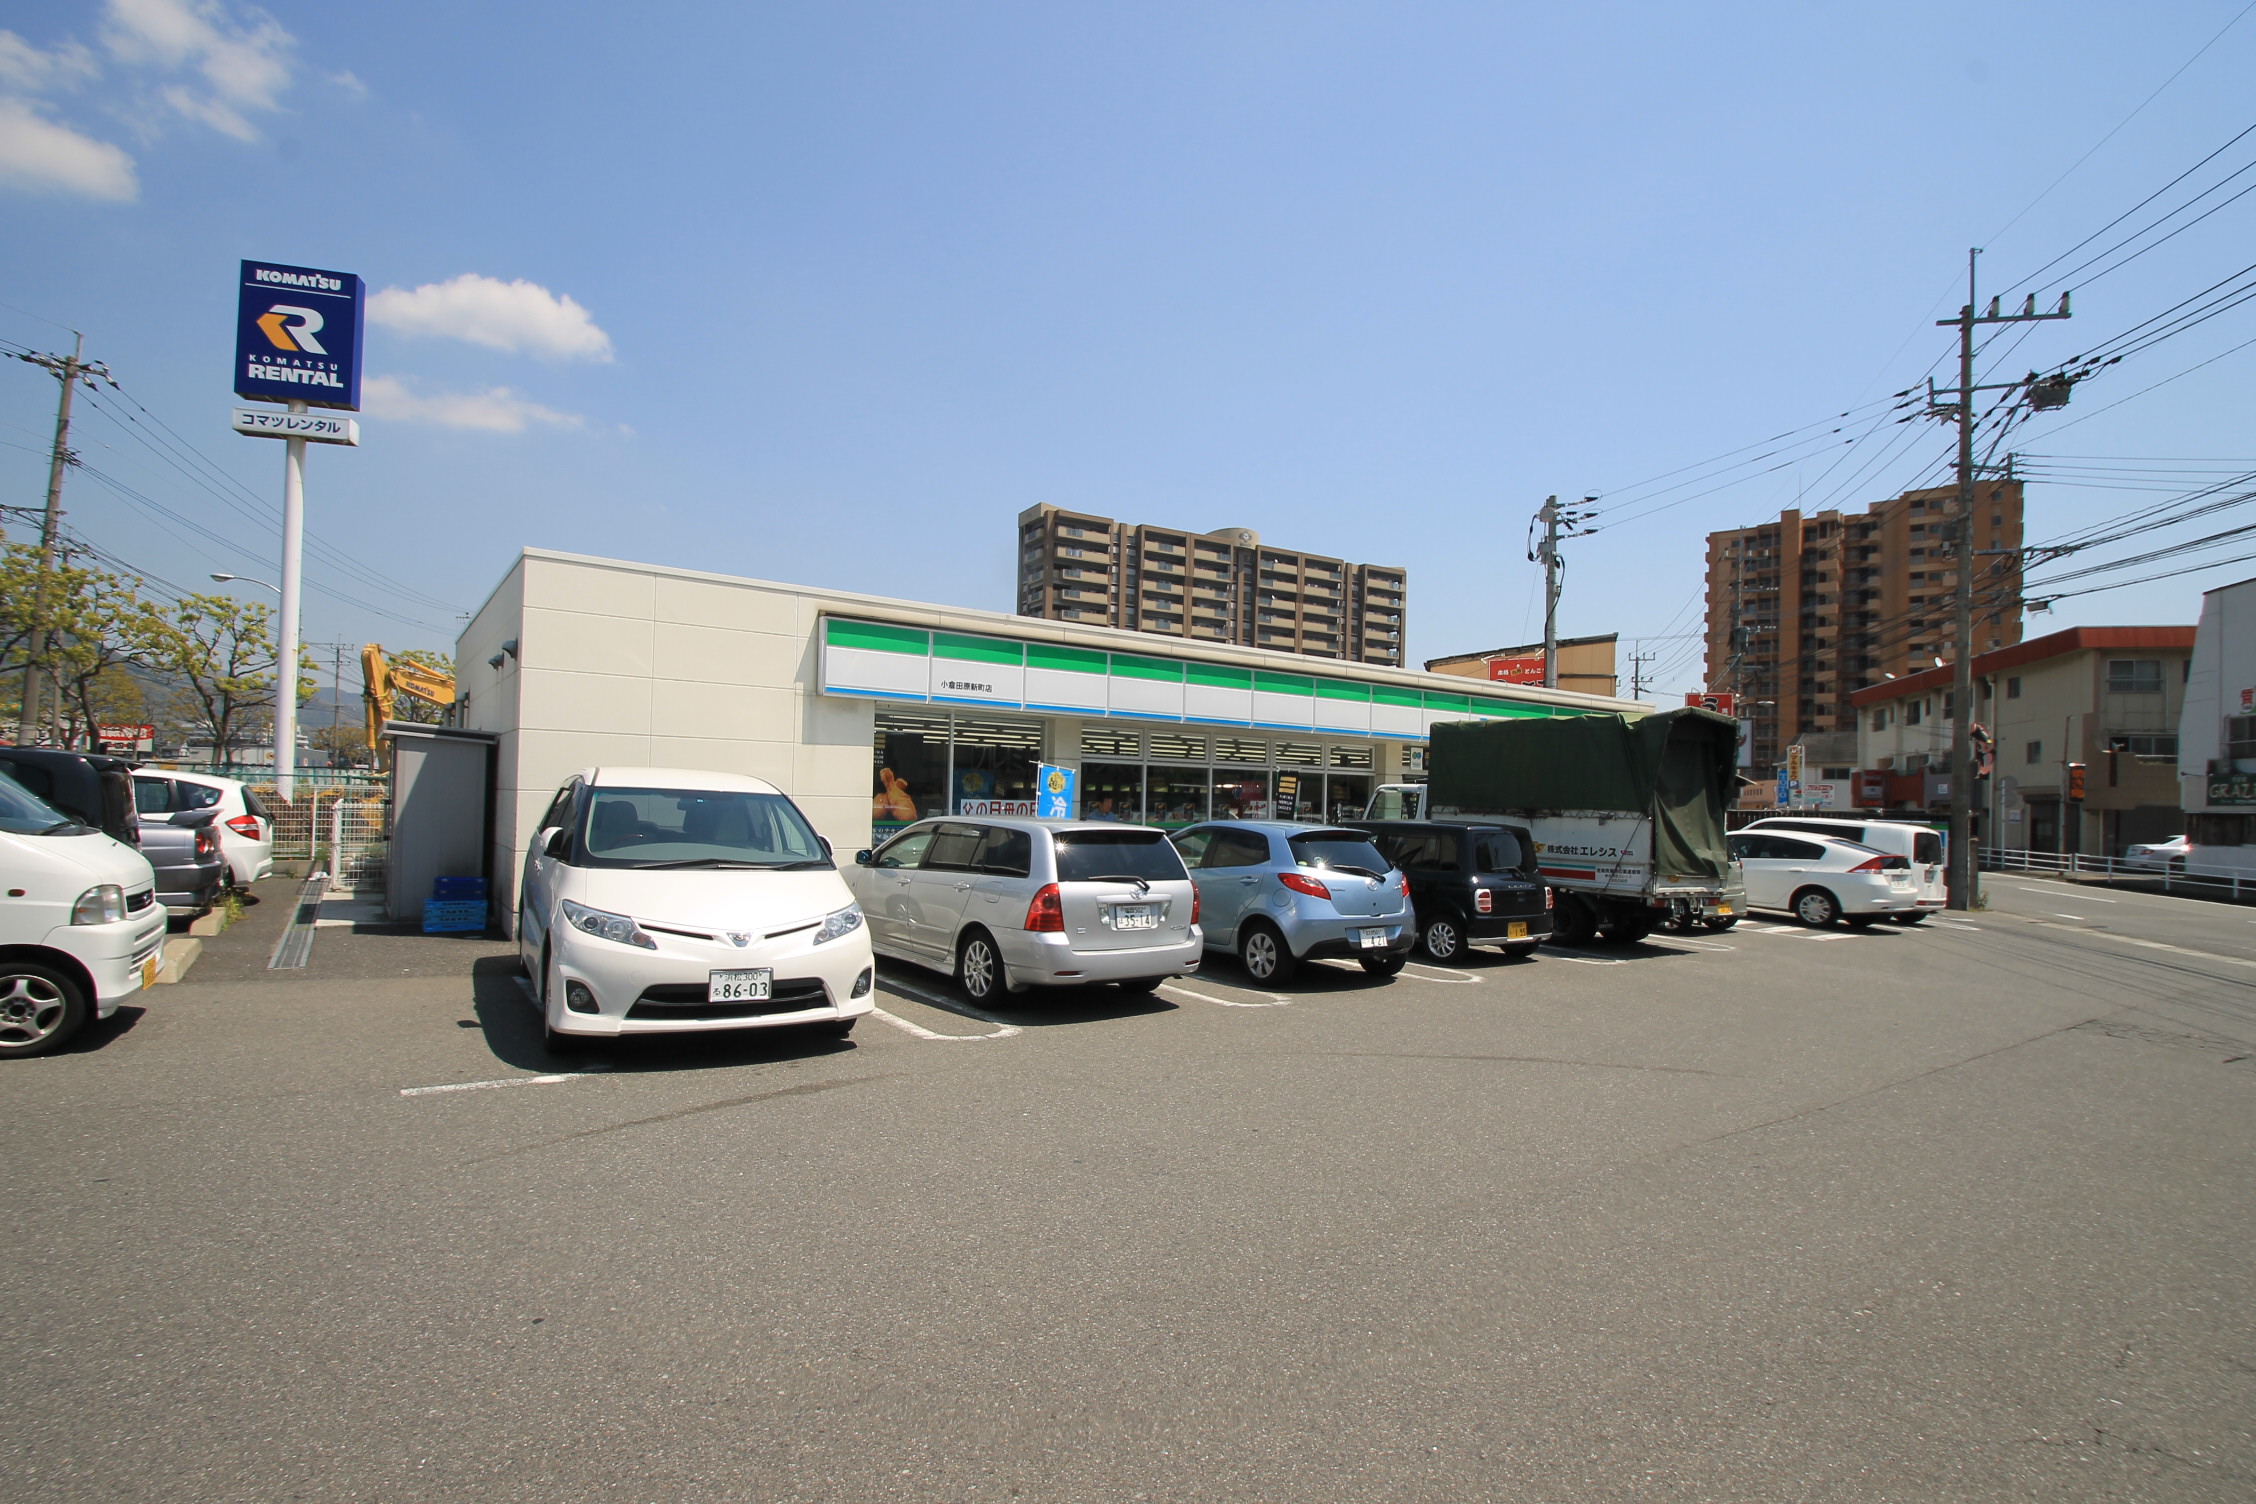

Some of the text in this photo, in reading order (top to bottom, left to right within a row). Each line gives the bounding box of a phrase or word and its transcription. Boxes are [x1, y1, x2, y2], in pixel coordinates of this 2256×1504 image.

[255, 268, 342, 291] KOMATSU
[248, 354, 338, 371] KOMATSU
[248, 363, 344, 388] RENTAL
[242, 413, 341, 434] コマツレンタル
[1779, 773, 1787, 798] TOTO
[723, 982, 768, 998] 86-03
